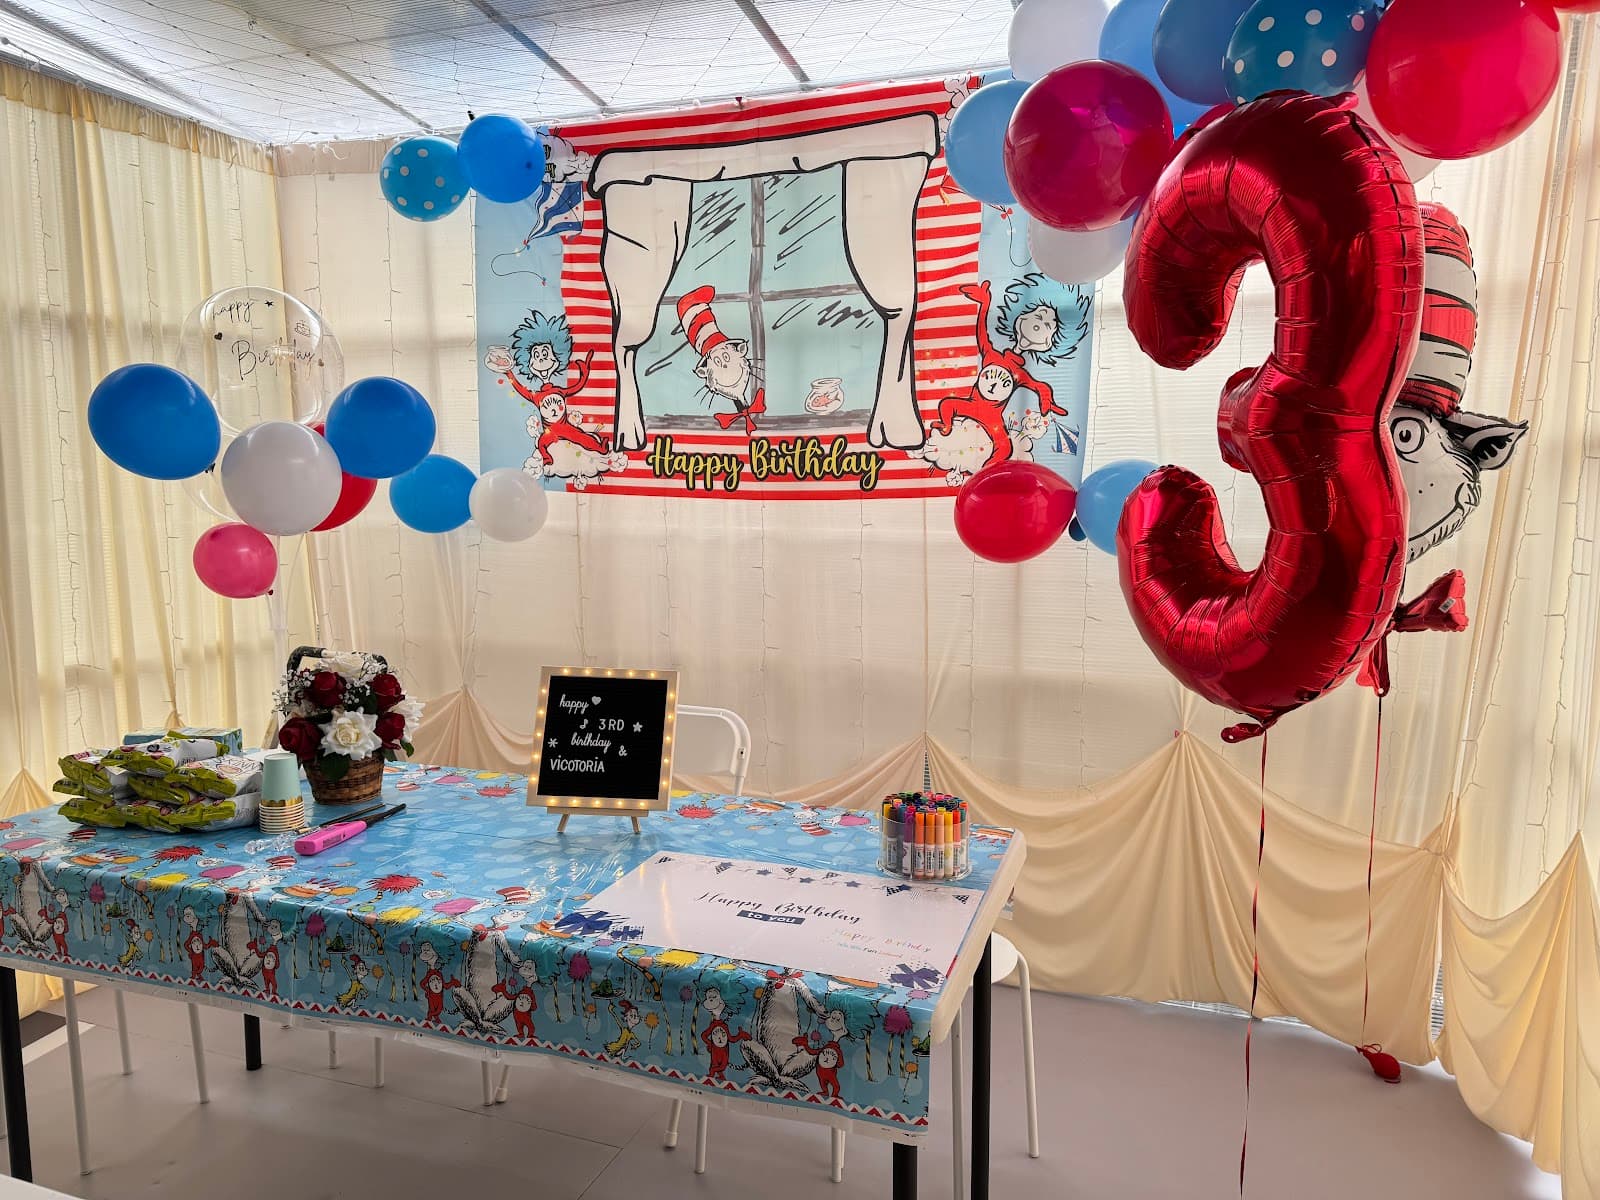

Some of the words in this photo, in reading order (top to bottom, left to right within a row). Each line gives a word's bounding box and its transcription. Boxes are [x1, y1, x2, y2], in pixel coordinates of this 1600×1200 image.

[983, 369, 1011, 387] THING
[987, 382, 998, 394] 1
[541, 397, 562, 410] THING
[551, 408, 558, 417] 2
[646, 435, 744, 491] Happy
[749, 436, 885, 491] Birthday
[560, 693, 589, 715] happy
[598, 718, 625, 732] 3RD
[570, 732, 611, 754] birthday
[692, 891, 763, 911] Happy
[774, 902, 863, 925] Birthday
[745, 912, 763, 921] to
[768, 915, 797, 925] you
